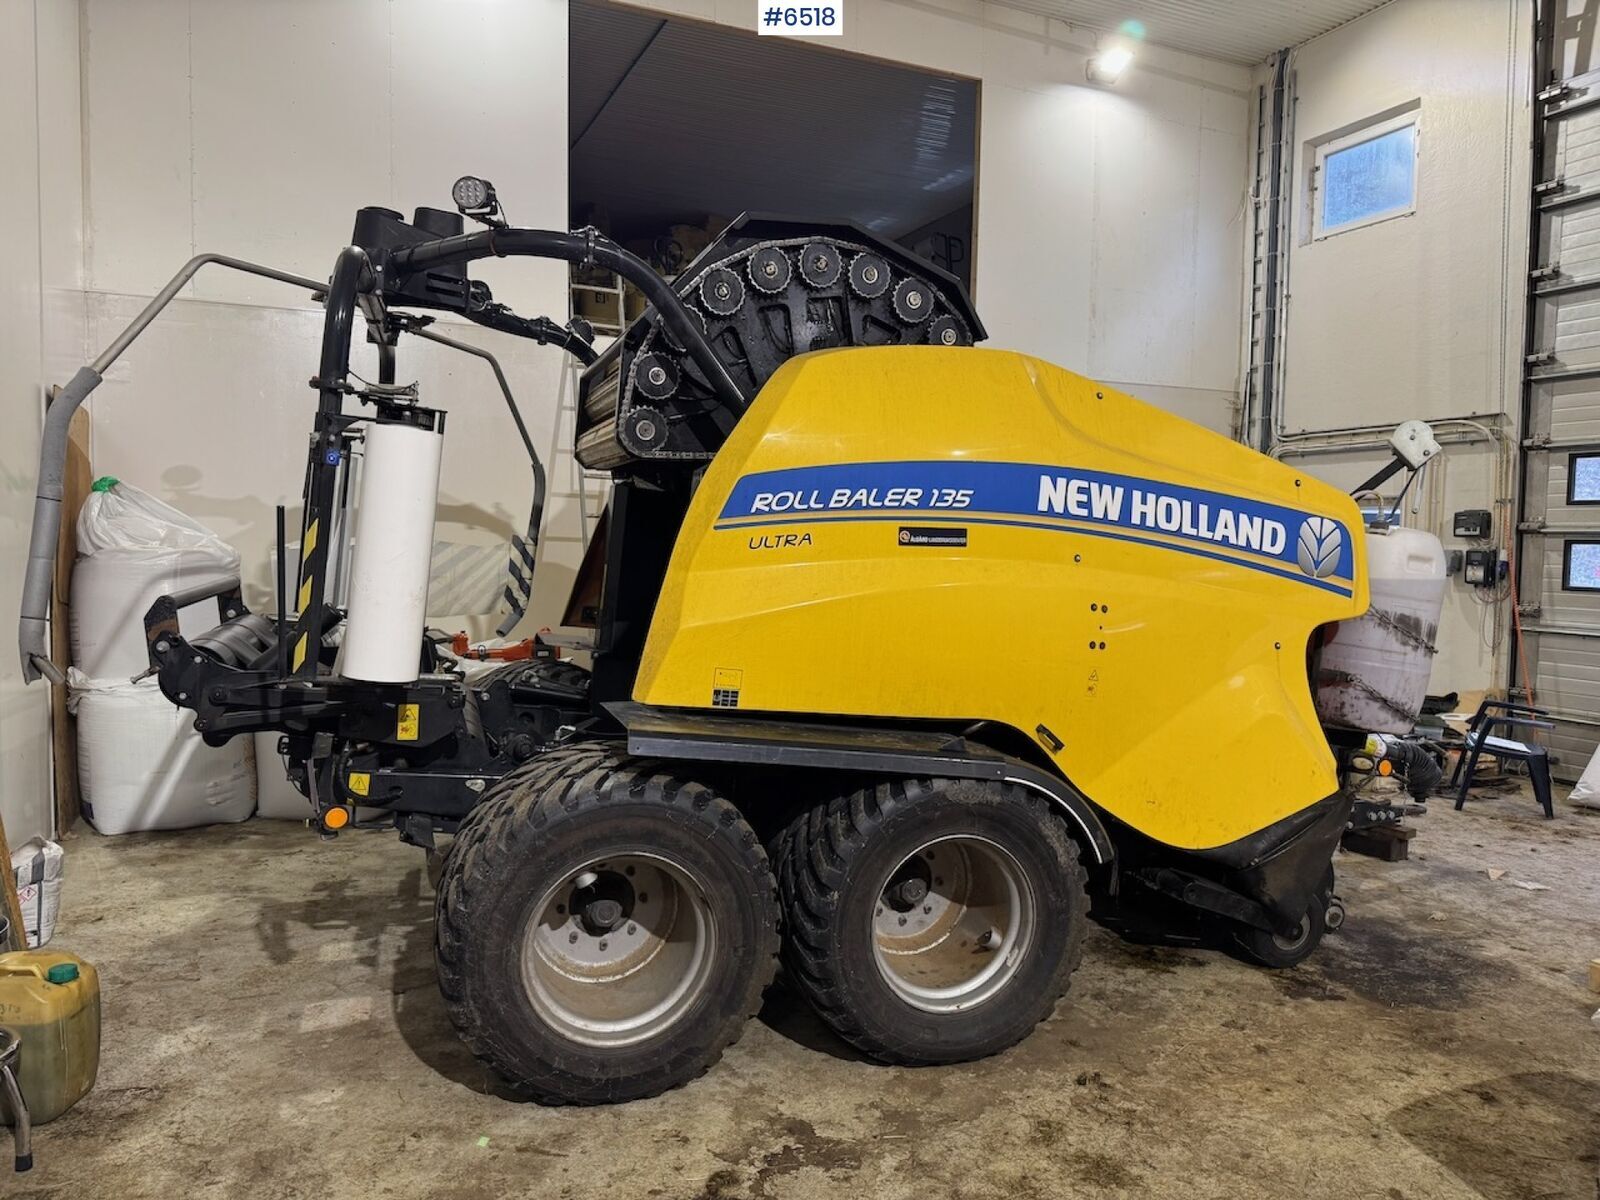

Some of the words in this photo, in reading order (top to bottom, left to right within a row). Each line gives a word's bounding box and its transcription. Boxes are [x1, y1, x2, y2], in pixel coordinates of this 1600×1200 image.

[751, 490, 825, 513] ROLL
[828, 488, 923, 509] BALER
[929, 488, 974, 508] 135
[1037, 474, 1125, 522] NEW
[1130, 489, 1287, 556] HOLLAND
[749, 532, 812, 550] ULTRA
